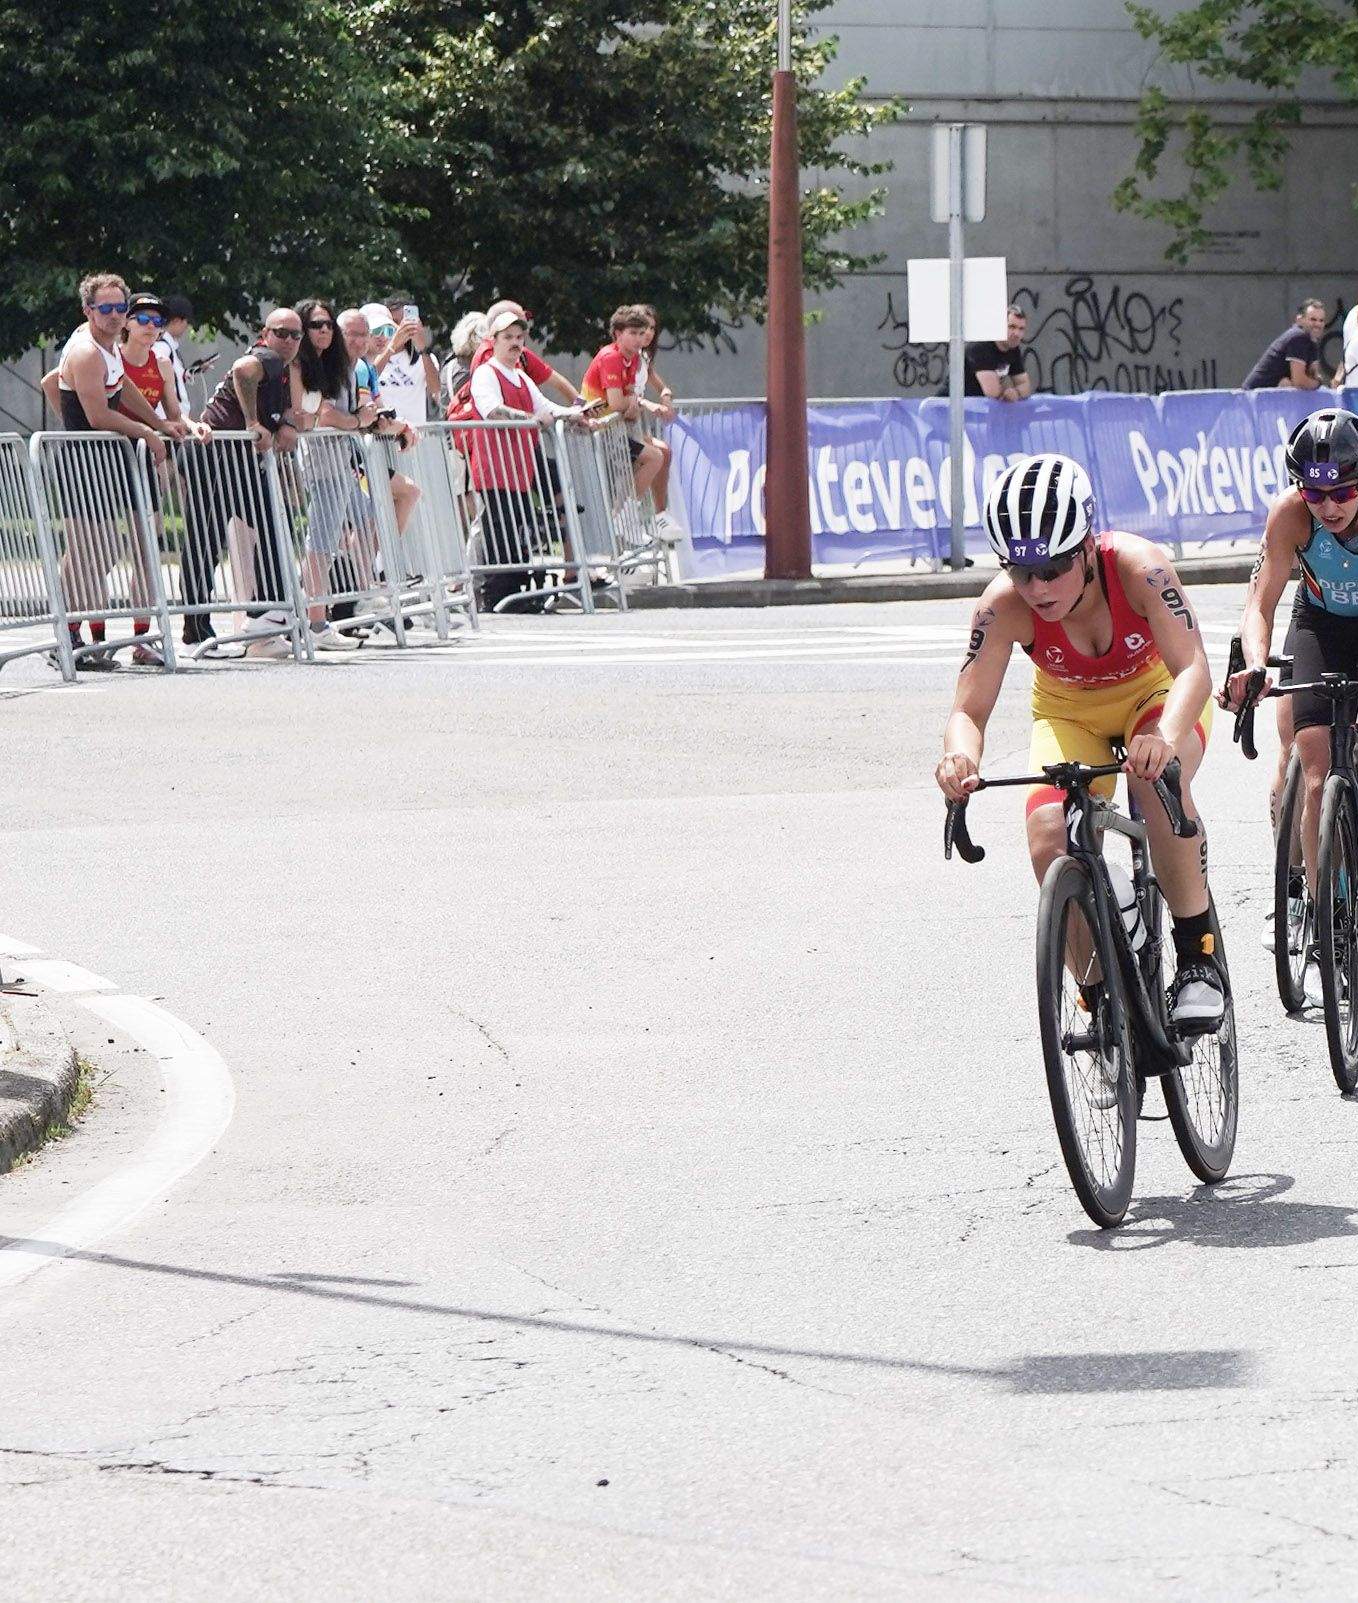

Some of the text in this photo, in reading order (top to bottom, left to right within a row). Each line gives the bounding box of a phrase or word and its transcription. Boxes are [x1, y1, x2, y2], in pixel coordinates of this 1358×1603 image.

[1309, 467, 1321, 478] 85
[1015, 545, 1027, 556] 97
[1160, 586, 1195, 631] 97
[960, 628, 986, 673] 97
